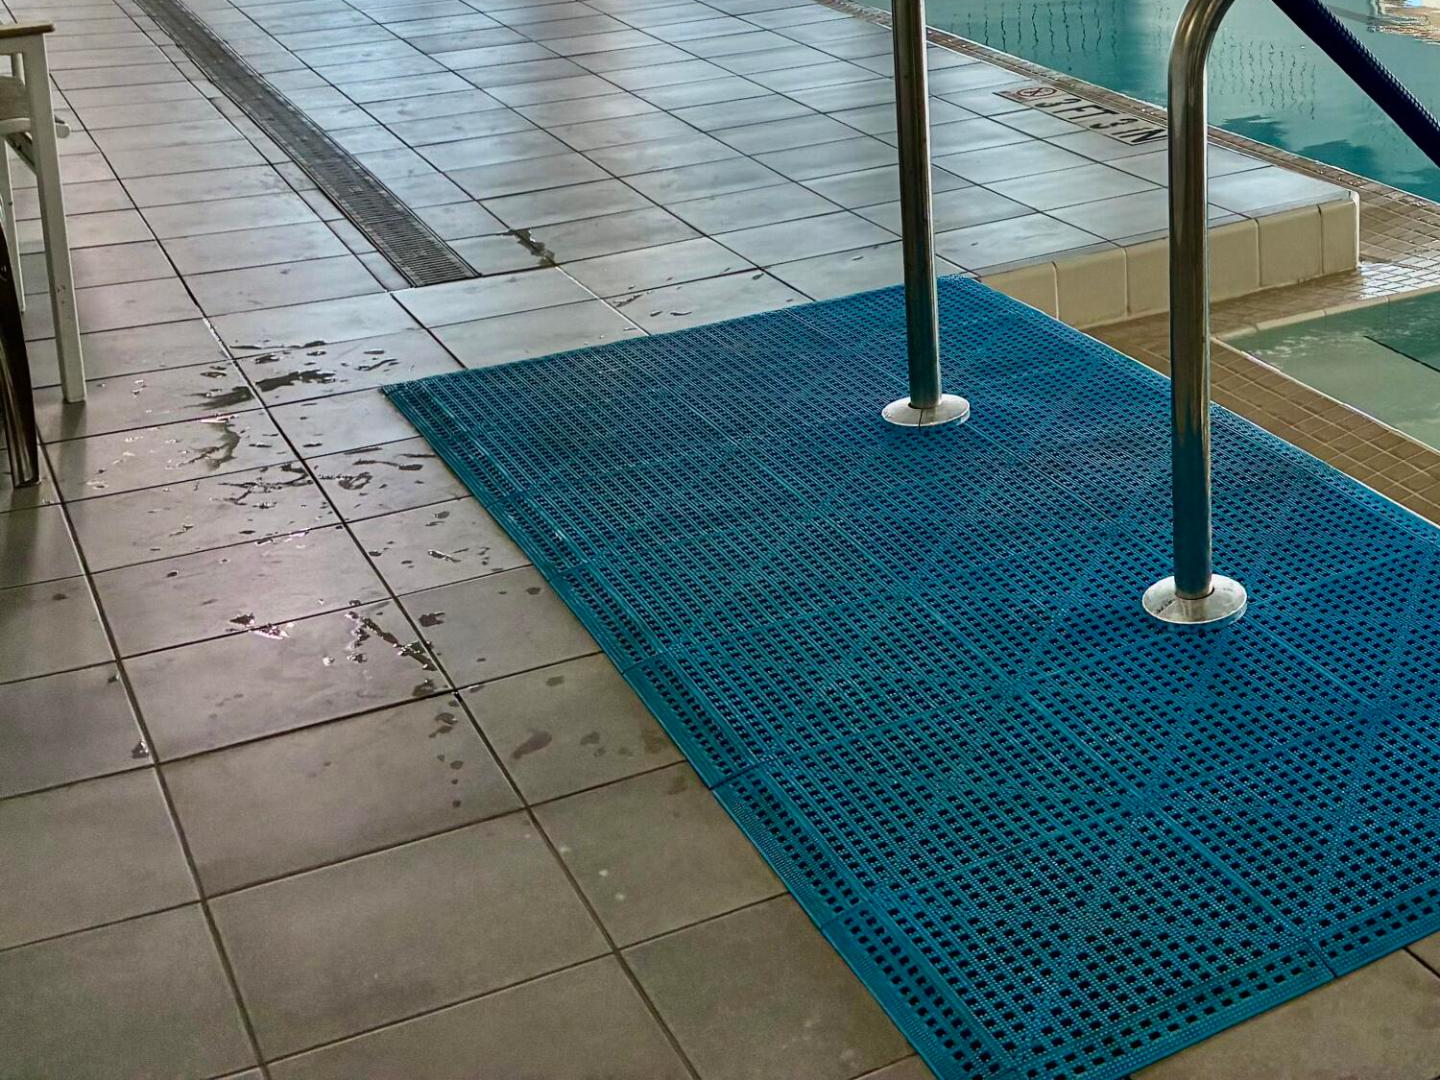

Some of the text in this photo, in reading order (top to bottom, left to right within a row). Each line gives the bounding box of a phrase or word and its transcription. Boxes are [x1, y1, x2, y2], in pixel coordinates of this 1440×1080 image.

[1034, 98, 1168, 143] 3 FT 3 IN
